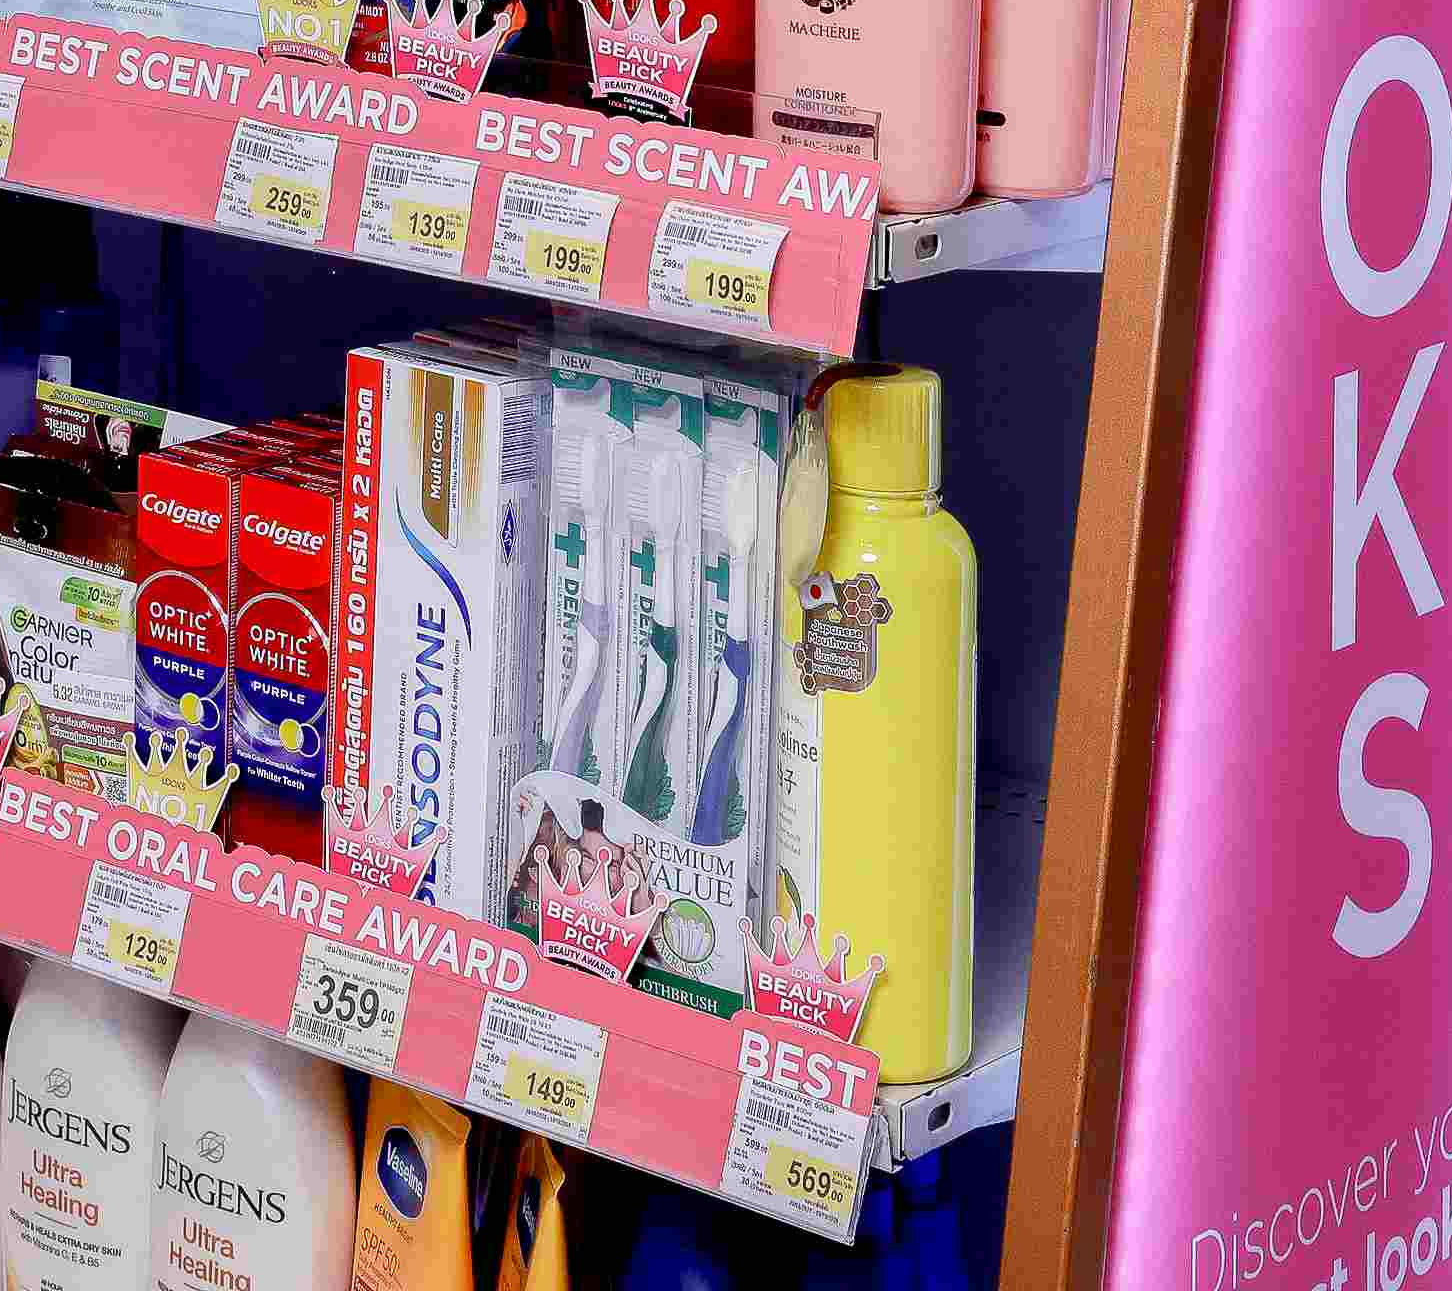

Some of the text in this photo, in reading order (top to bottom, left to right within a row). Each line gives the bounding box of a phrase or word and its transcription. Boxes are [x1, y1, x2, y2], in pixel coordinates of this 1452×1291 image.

[596, 39, 690, 75] BEAUTY
[616, 59, 666, 84] PICK
[8, 25, 420, 139] BEST SCENT AWARD
[473, 106, 599, 171] BEST
[603, 134, 770, 206] SCENT
[140, 492, 224, 535] Colgate
[10, 607, 94, 651] GARNIER
[18, 635, 80, 672] Color
[151, 654, 206, 682] PURPLE
[631, 829, 736, 881] PREMIUM
[105, 817, 226, 891] ORAL
[230, 859, 346, 930] CARE
[353, 905, 530, 994] AWARD
[735, 1028, 870, 1110] BEST
[156, 1140, 289, 1225] JERGENS
